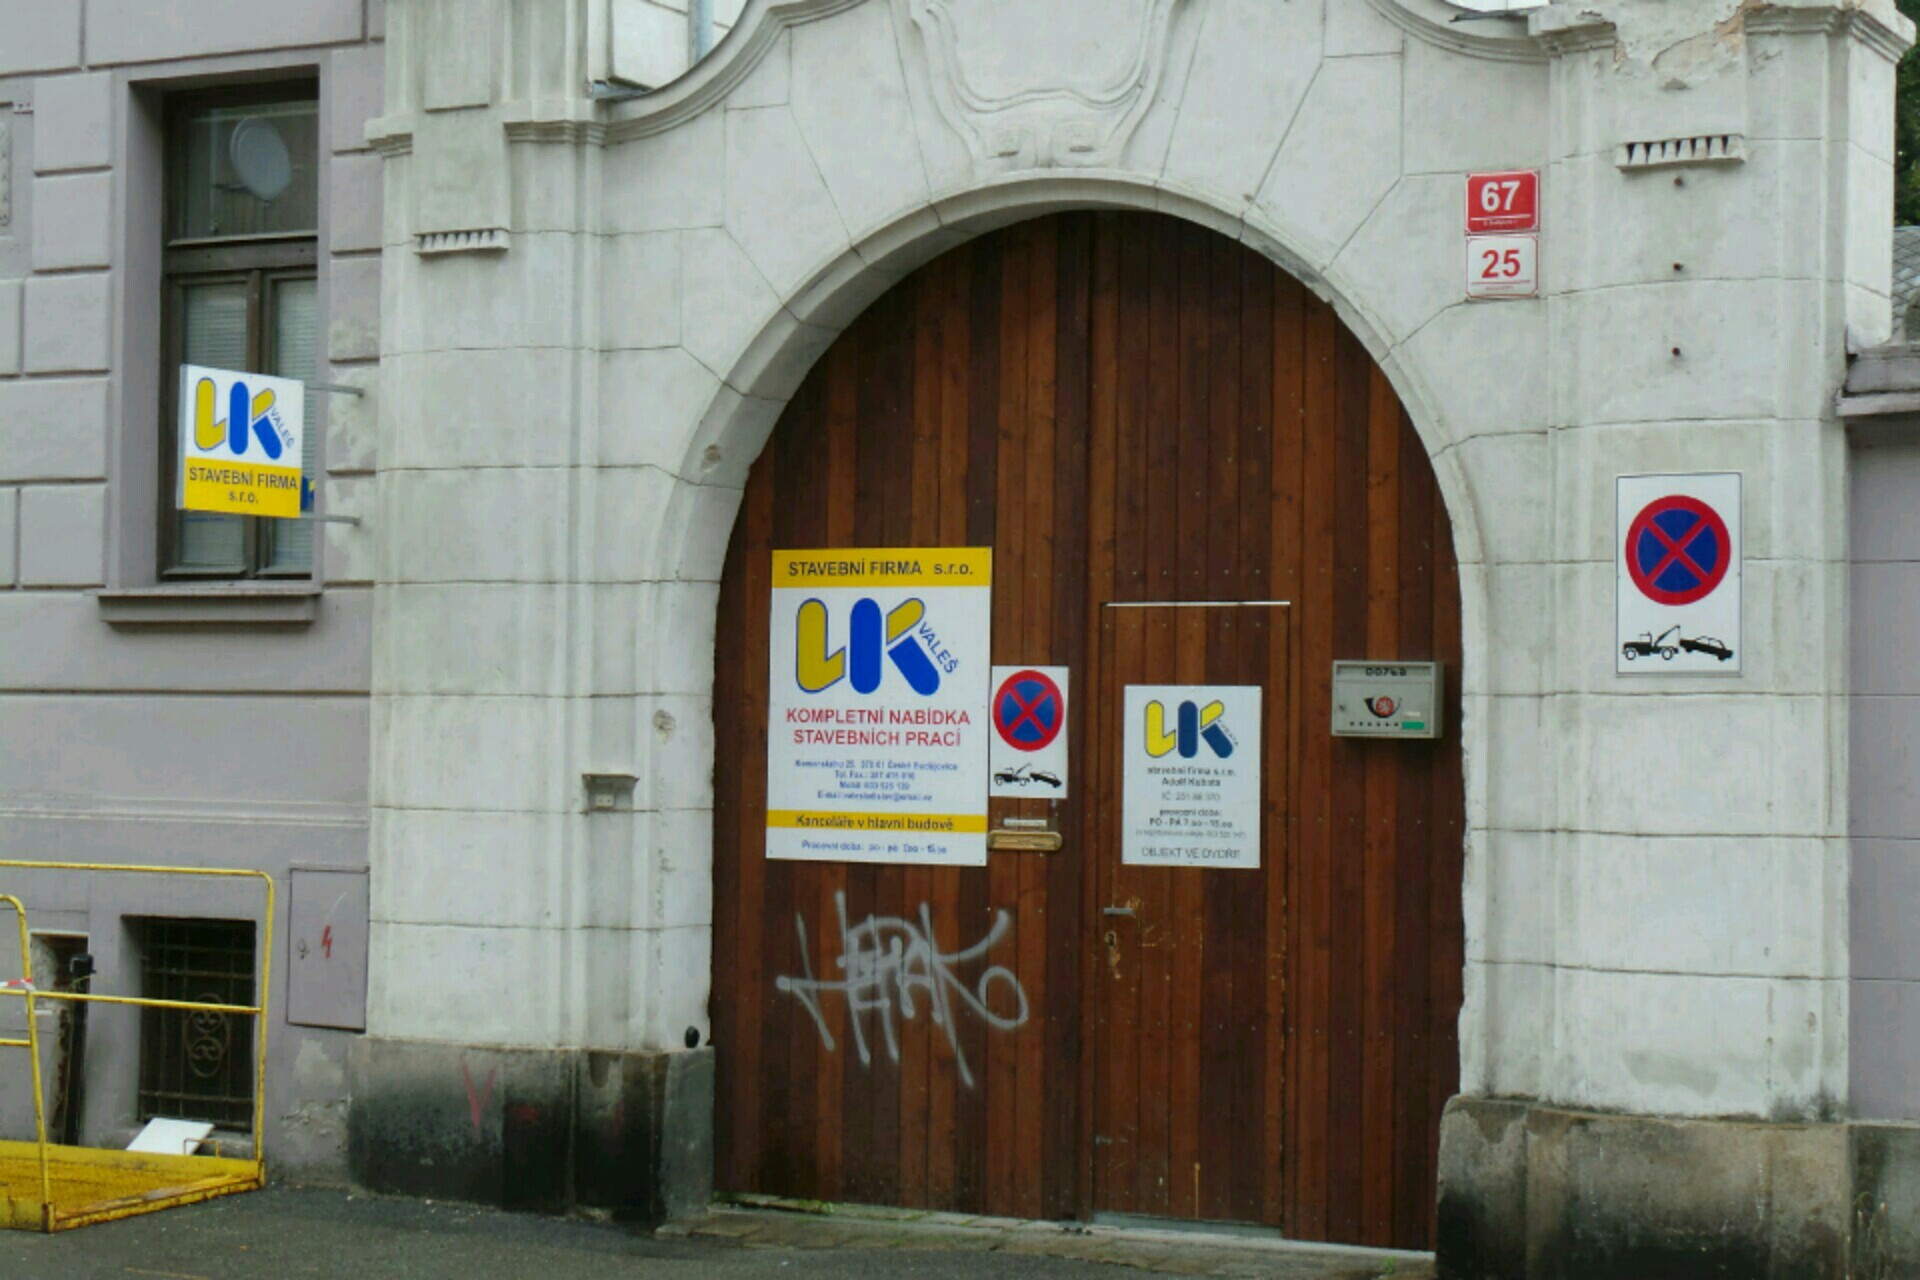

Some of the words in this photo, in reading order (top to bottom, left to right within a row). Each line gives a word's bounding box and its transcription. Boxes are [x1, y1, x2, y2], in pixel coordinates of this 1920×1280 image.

[1481, 181, 1521, 212] 67
[1481, 248, 1521, 279] 25
[189, 467, 253, 486] STAVEBNÍ
[257, 473, 299, 490] FIRMA
[789, 558, 865, 577] STAVEBNÍ
[869, 560, 923, 576] FIRMA
[933, 562, 974, 576] s.r.o.
[918, 621, 960, 675] VALEŠ
[786, 706, 885, 725] KOMPLETNÍ
[889, 707, 971, 726] NABÍDKA
[793, 728, 900, 746] STAVEBNÍCH
[904, 728, 962, 747] PRACÍ
[796, 814, 855, 829] Kanceláře
[858, 819, 865, 829] v
[867, 815, 905, 830] hlavní
[907, 817, 953, 832] budově
[1185, 847, 1200, 859] VE
